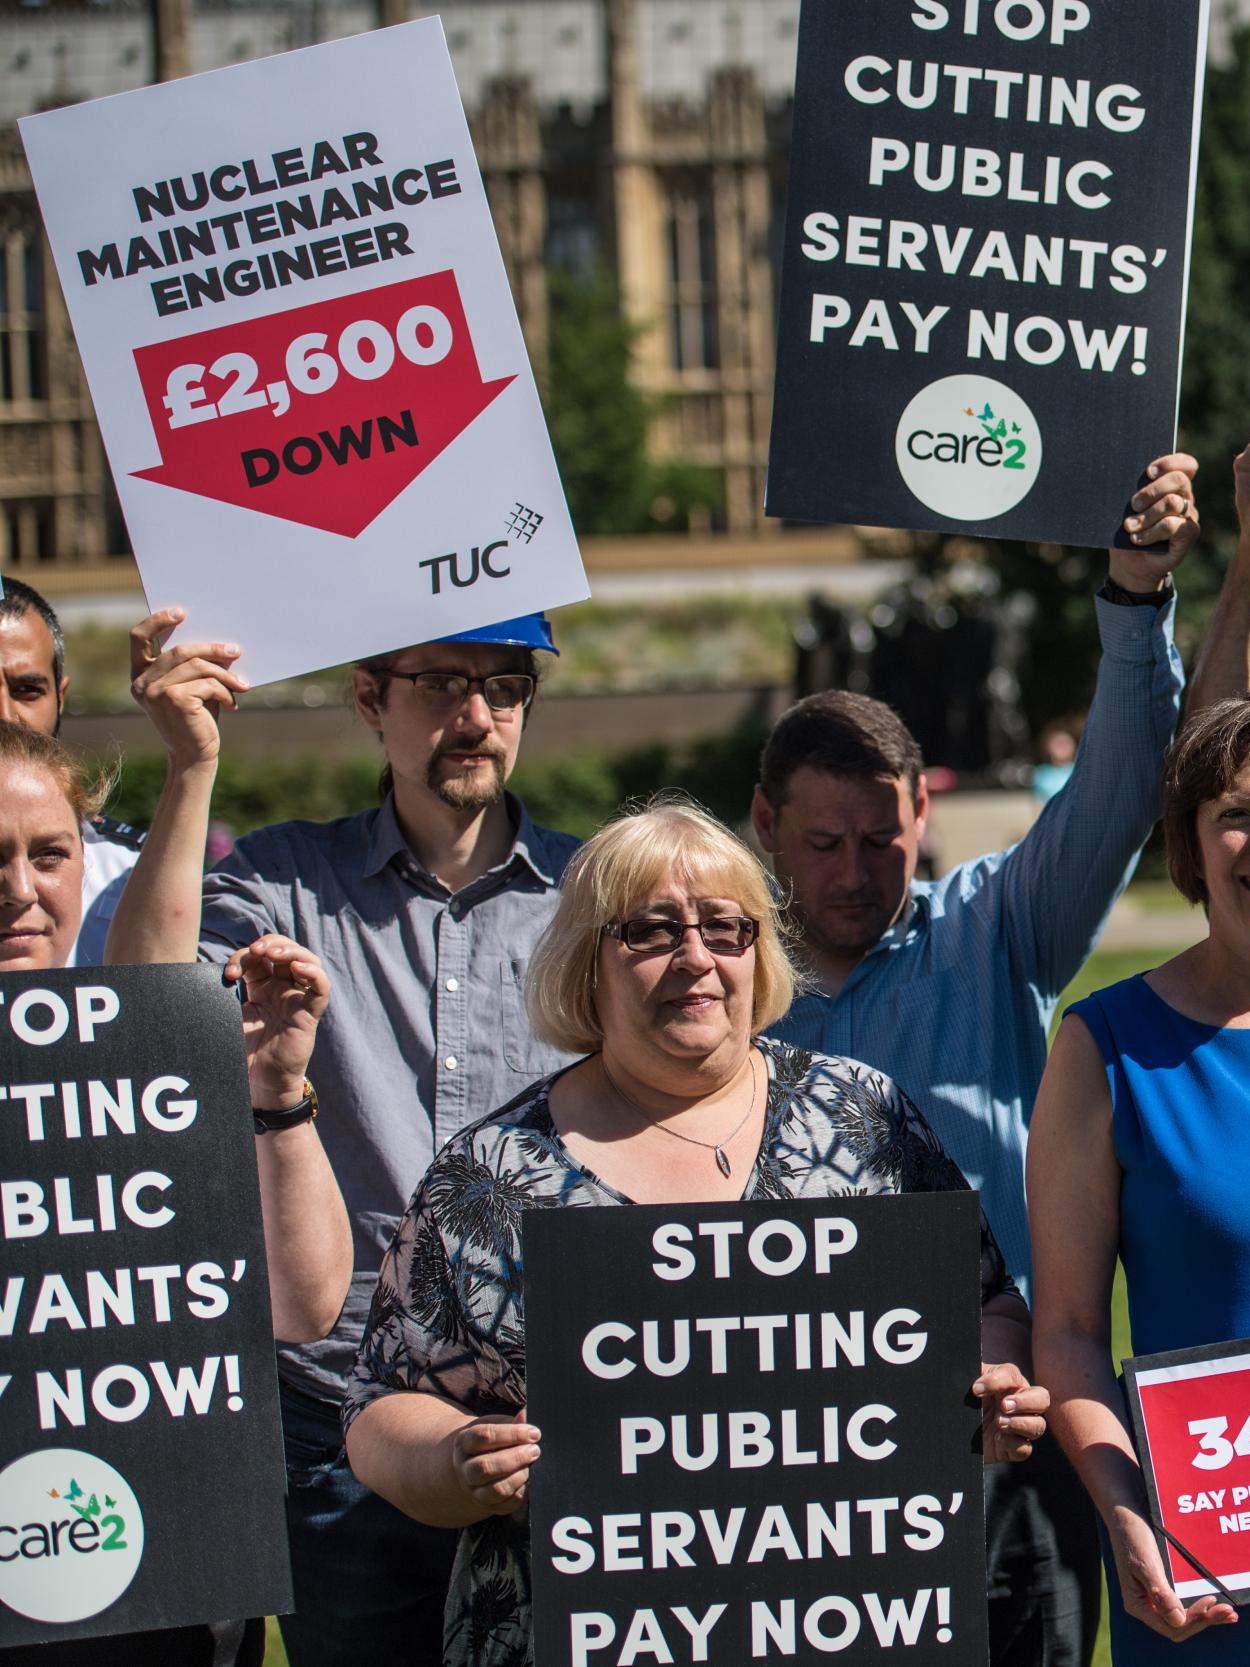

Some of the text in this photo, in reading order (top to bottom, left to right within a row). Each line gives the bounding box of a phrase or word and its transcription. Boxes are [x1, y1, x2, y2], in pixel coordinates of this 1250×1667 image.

[911, 0, 1090, 45] STOP
[845, 56, 1145, 132] CUTTING
[132, 132, 383, 223] NUCLEAR
[869, 137, 1113, 209] PUBLIC
[77, 159, 461, 286] MAINTENANCE
[801, 212, 1167, 294] SERVANTS'
[150, 222, 414, 317] ENGINEER
[163, 305, 452, 429] £2,600
[810, 294, 1148, 375] PAY NOW!
[240, 410, 418, 488] DOWN
[907, 430, 1026, 470] care2
[419, 541, 510, 594] TUC
[0, 986, 120, 1045] OP
[0, 1076, 197, 1140] TING
[653, 1218, 857, 1280] STOP
[582, 1309, 927, 1379] CUTTING
[37, 1355, 243, 1429] NOW!
[621, 1404, 897, 1473] PUBLIC
[552, 1492, 963, 1573] SERVANTS'
[1178, 1489, 1225, 1513] SAY
[571, 1587, 952, 1667] PAY NOW!
